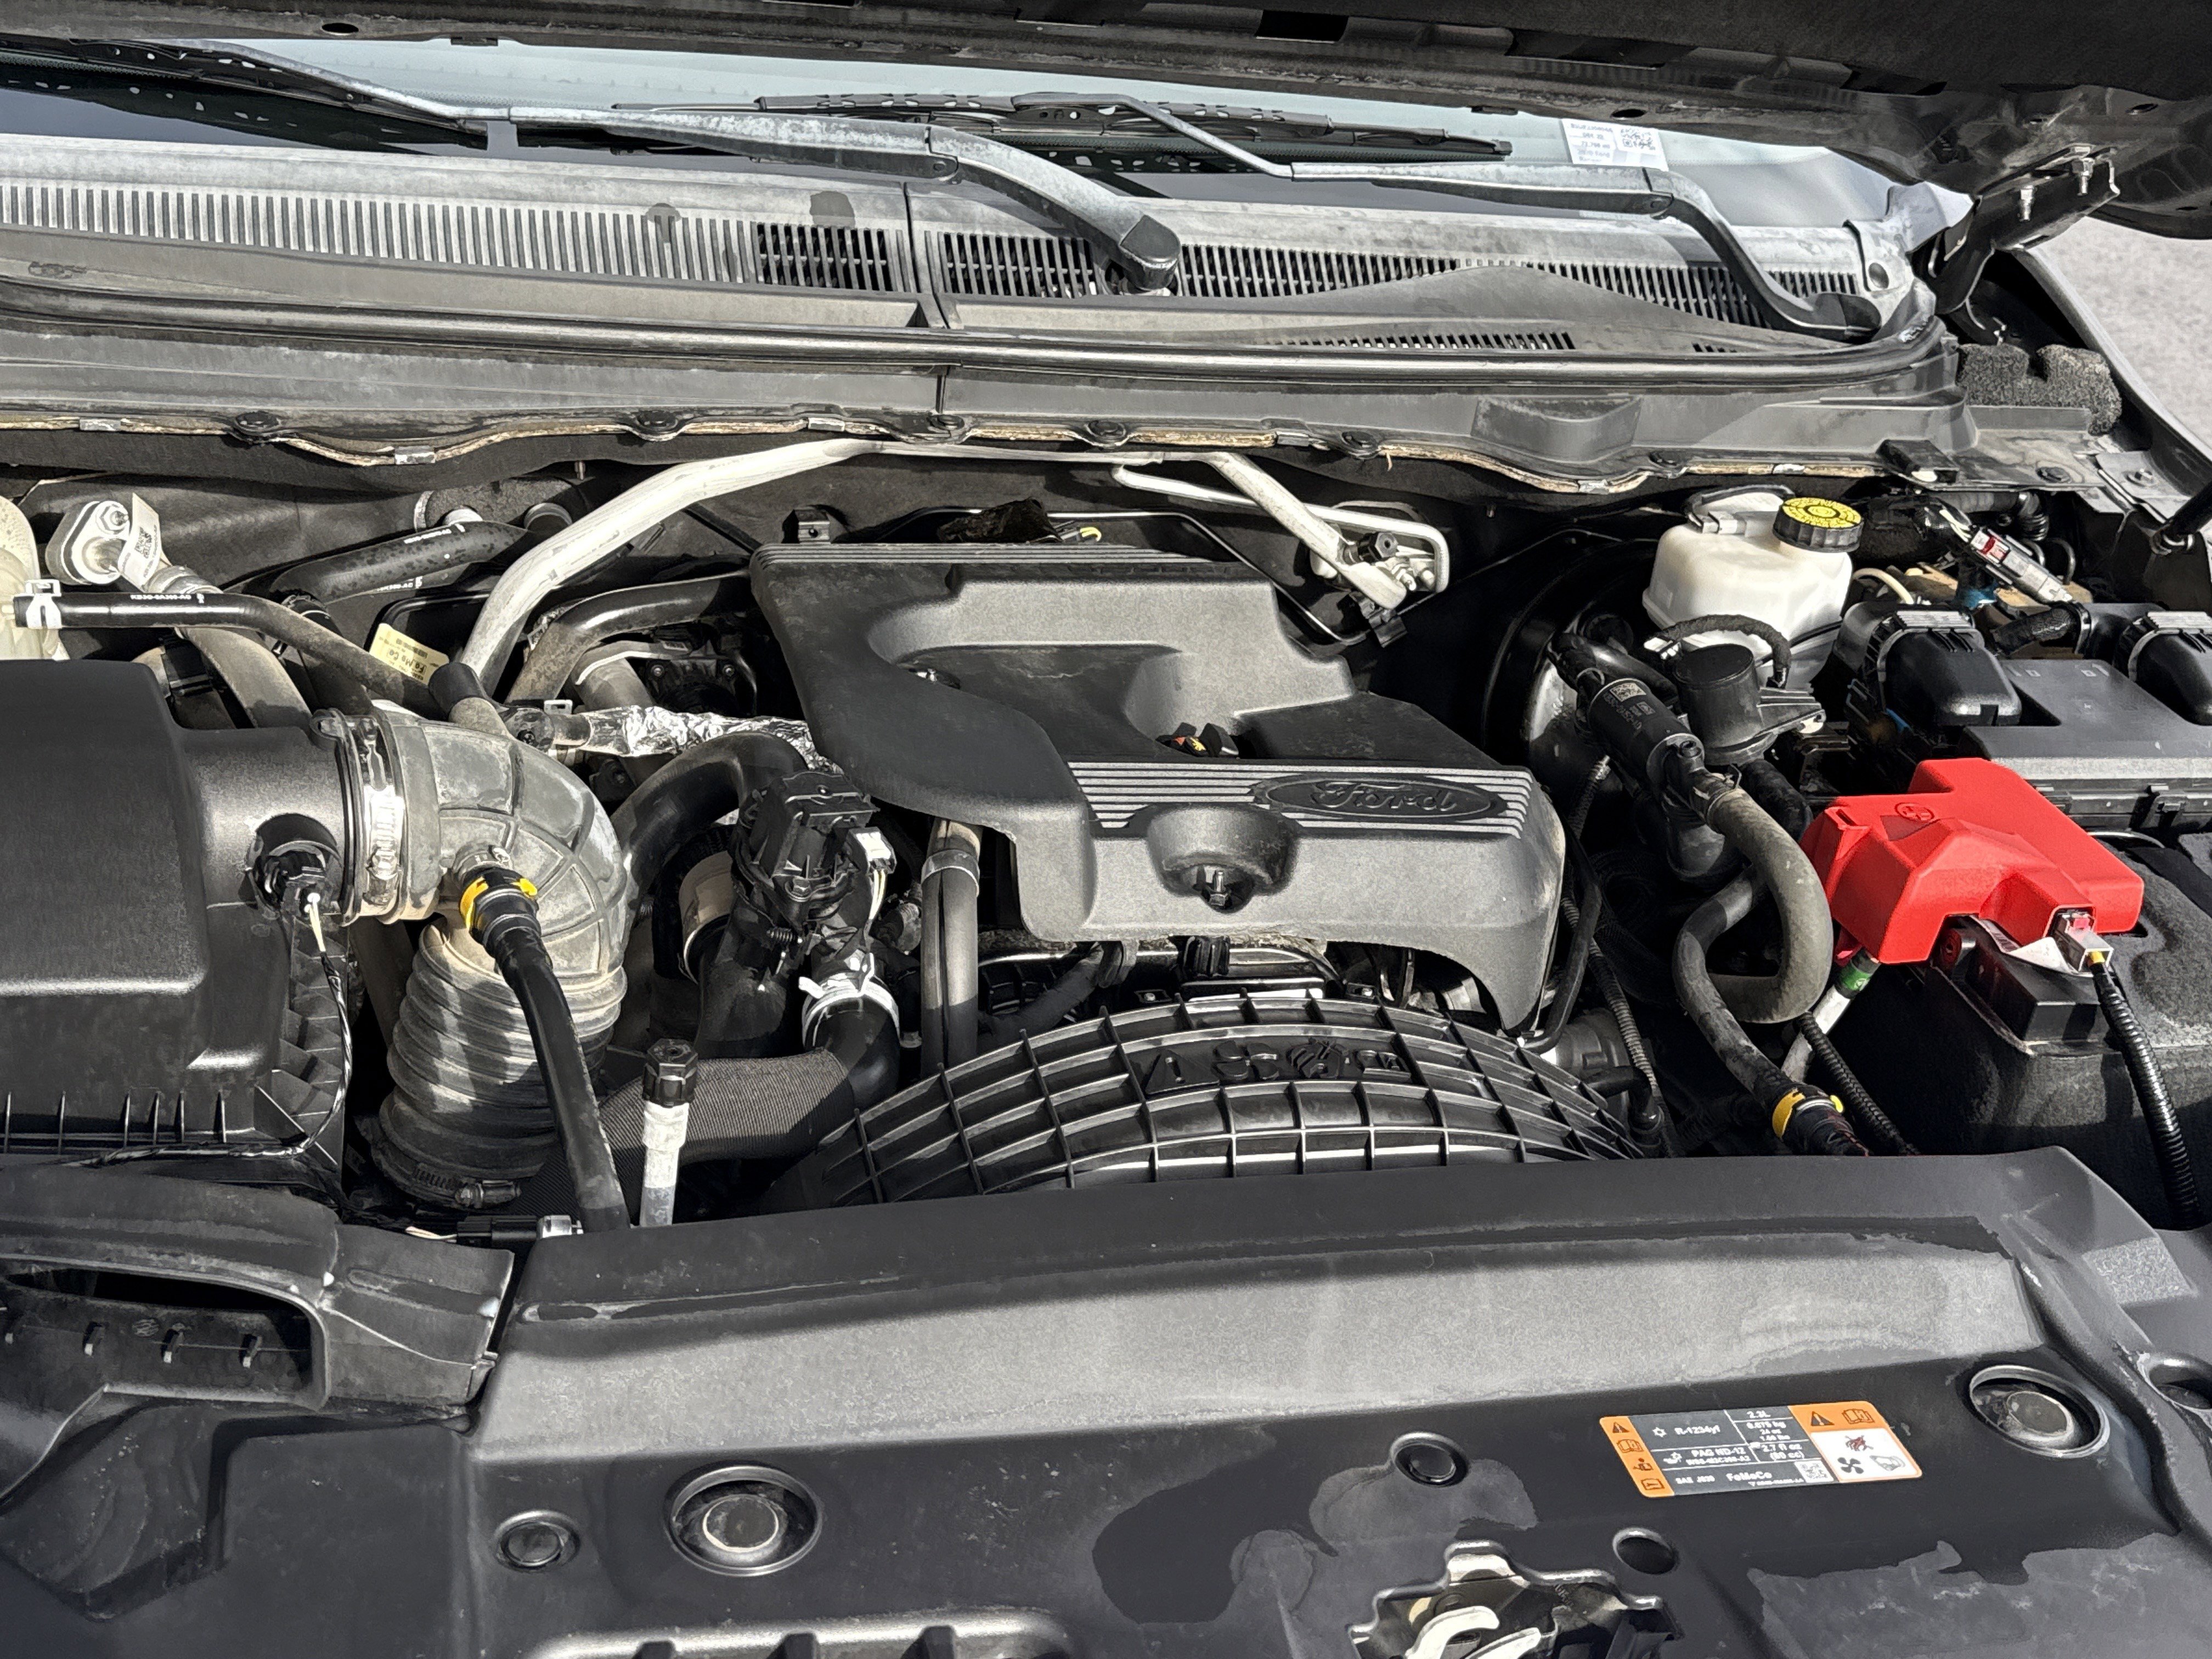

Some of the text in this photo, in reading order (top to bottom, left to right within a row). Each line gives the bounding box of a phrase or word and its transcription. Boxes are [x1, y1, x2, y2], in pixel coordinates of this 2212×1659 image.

[1310, 781, 1458, 812] Ford
[1674, 1425, 1721, 1435] R-1234yf
[1691, 1449, 1715, 1457] PAG
[1725, 1471, 1773, 1482] FoMoCo
